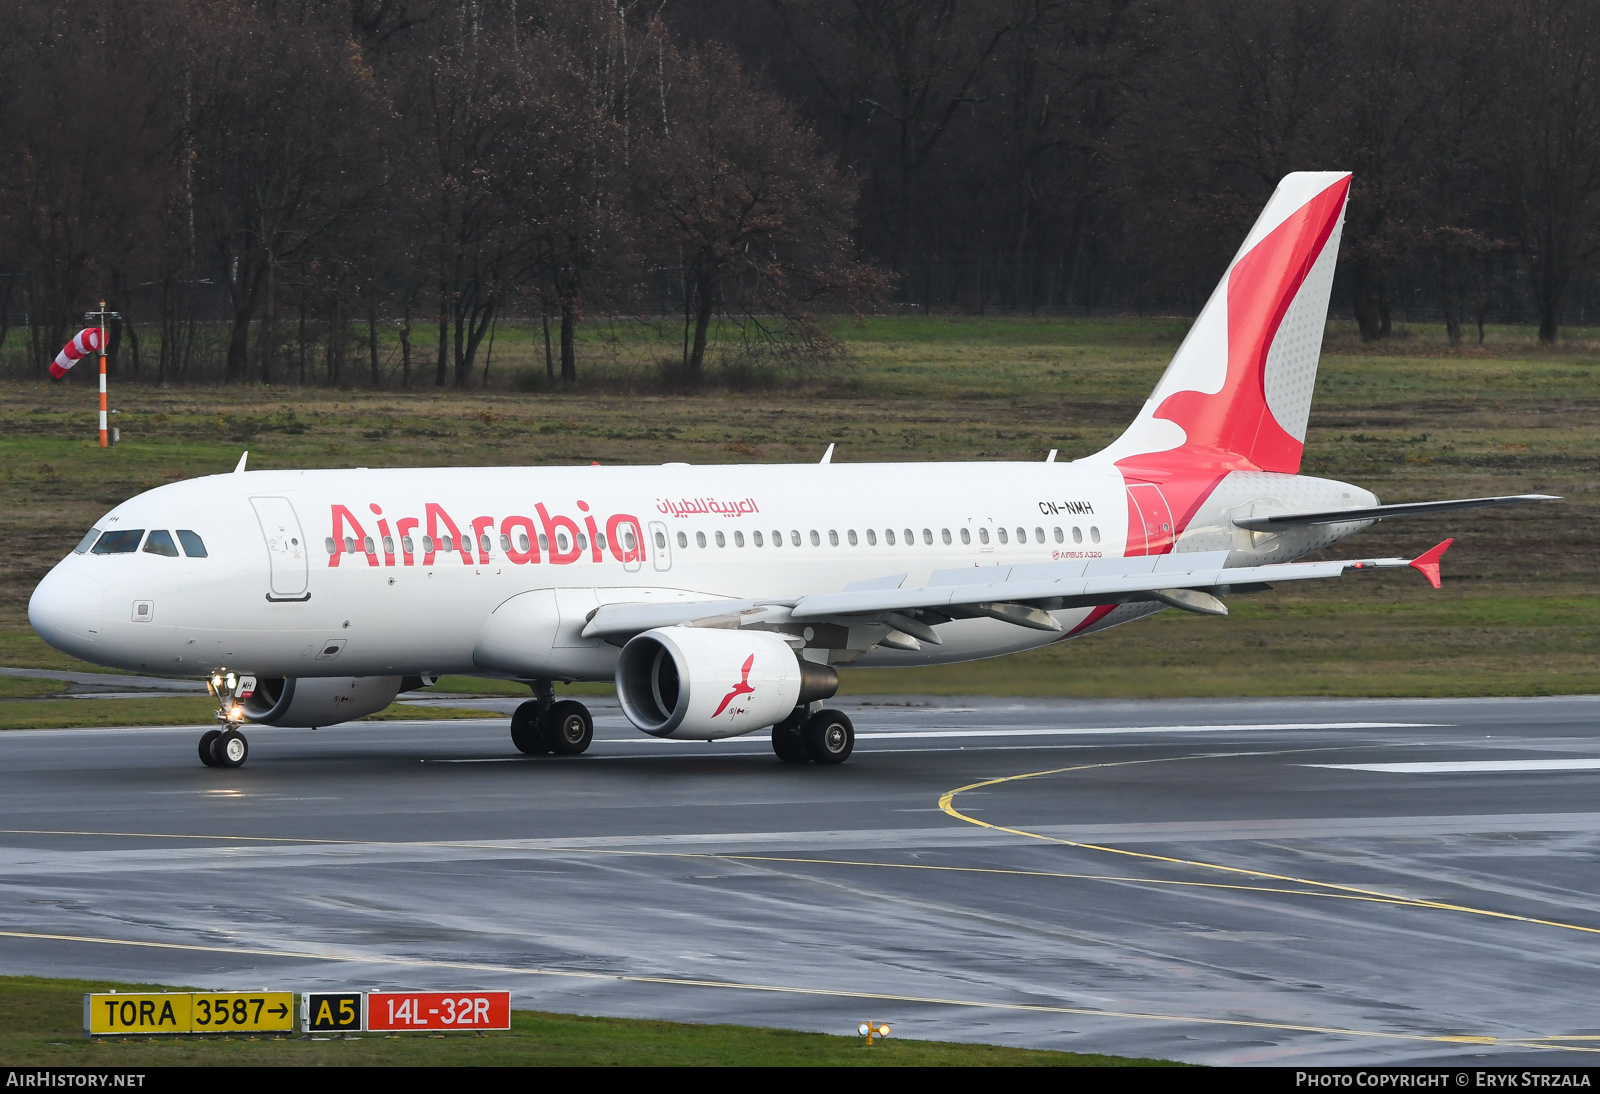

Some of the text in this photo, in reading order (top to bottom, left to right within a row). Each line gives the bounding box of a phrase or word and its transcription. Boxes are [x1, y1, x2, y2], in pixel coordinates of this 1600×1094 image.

[656, 498, 760, 519] العربية للطيران
[1038, 501, 1094, 515] CN-NMH
[328, 500, 646, 568] AirArabia
[1060, 551, 1103, 559] AIRBUS A320
[104, 998, 265, 1027] TORA 3587
[314, 998, 355, 1026] A5
[387, 997, 490, 1026] 14L-32R
